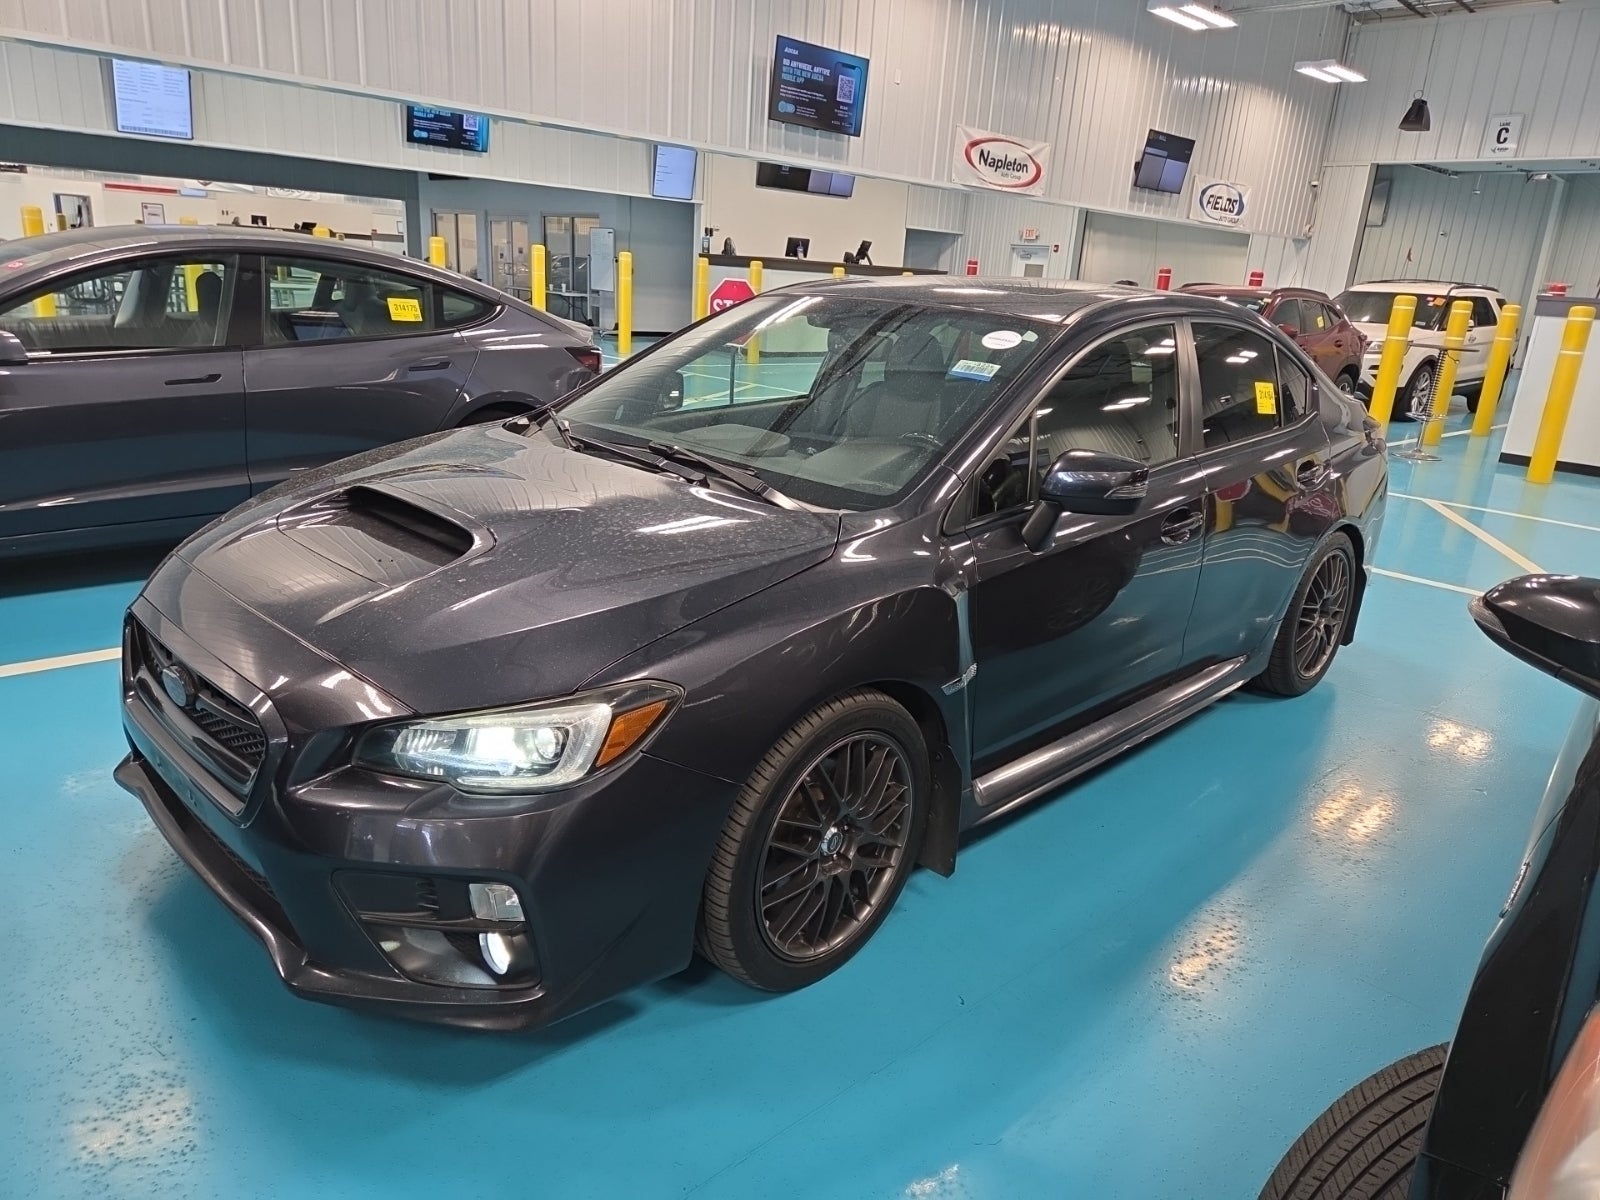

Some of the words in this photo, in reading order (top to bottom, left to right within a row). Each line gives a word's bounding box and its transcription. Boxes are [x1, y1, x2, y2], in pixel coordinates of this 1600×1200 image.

[1496, 127, 1510, 144] C
[978, 148, 1029, 174] Napleton
[1206, 194, 1239, 214] FIELDS
